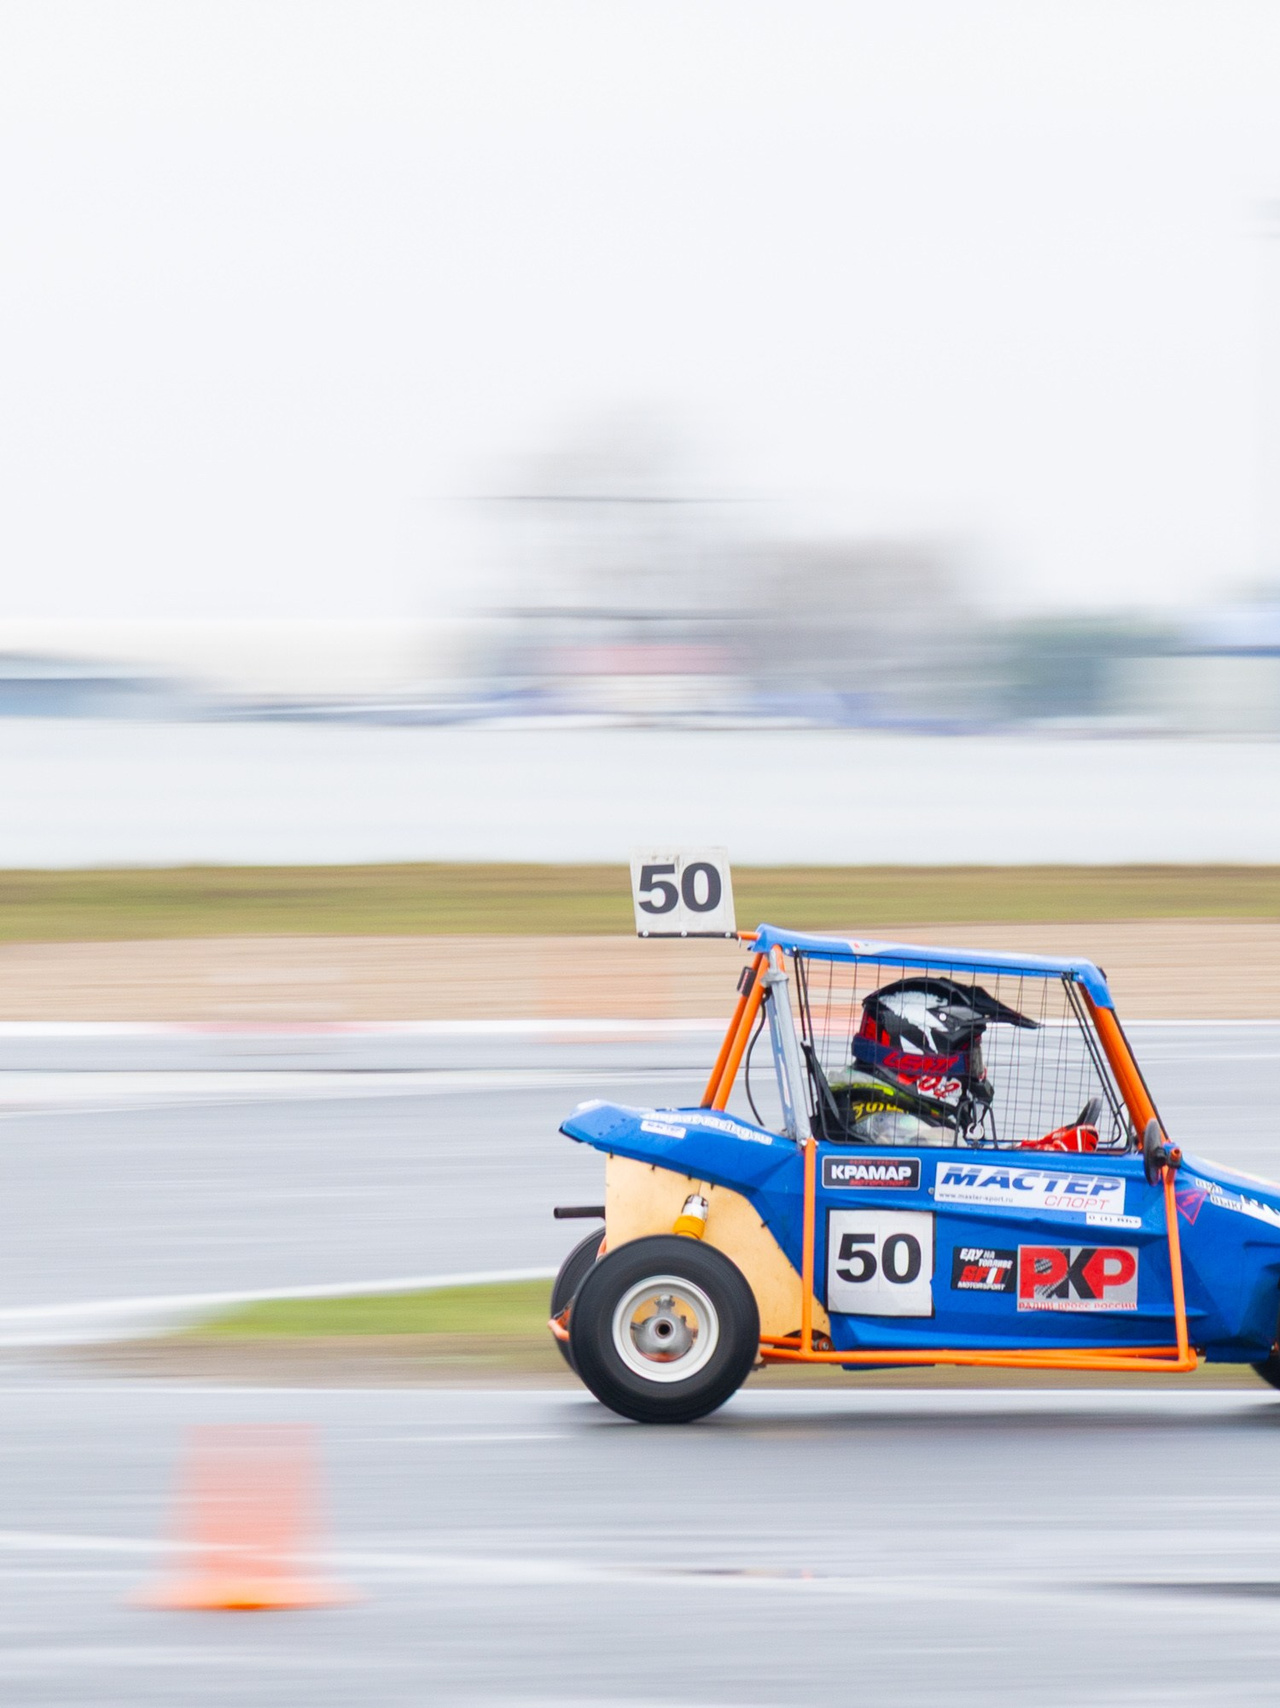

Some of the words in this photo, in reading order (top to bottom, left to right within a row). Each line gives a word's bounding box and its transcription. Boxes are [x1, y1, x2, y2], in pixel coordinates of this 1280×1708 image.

[637, 861, 722, 915] 50
[831, 1164, 912, 1181] КРАМАР
[940, 1166, 1122, 1197] МАСТЕР
[1044, 1195, 1111, 1211] СПОРТ
[835, 1233, 922, 1284] 50
[959, 1248, 984, 1262] ЕДУ
